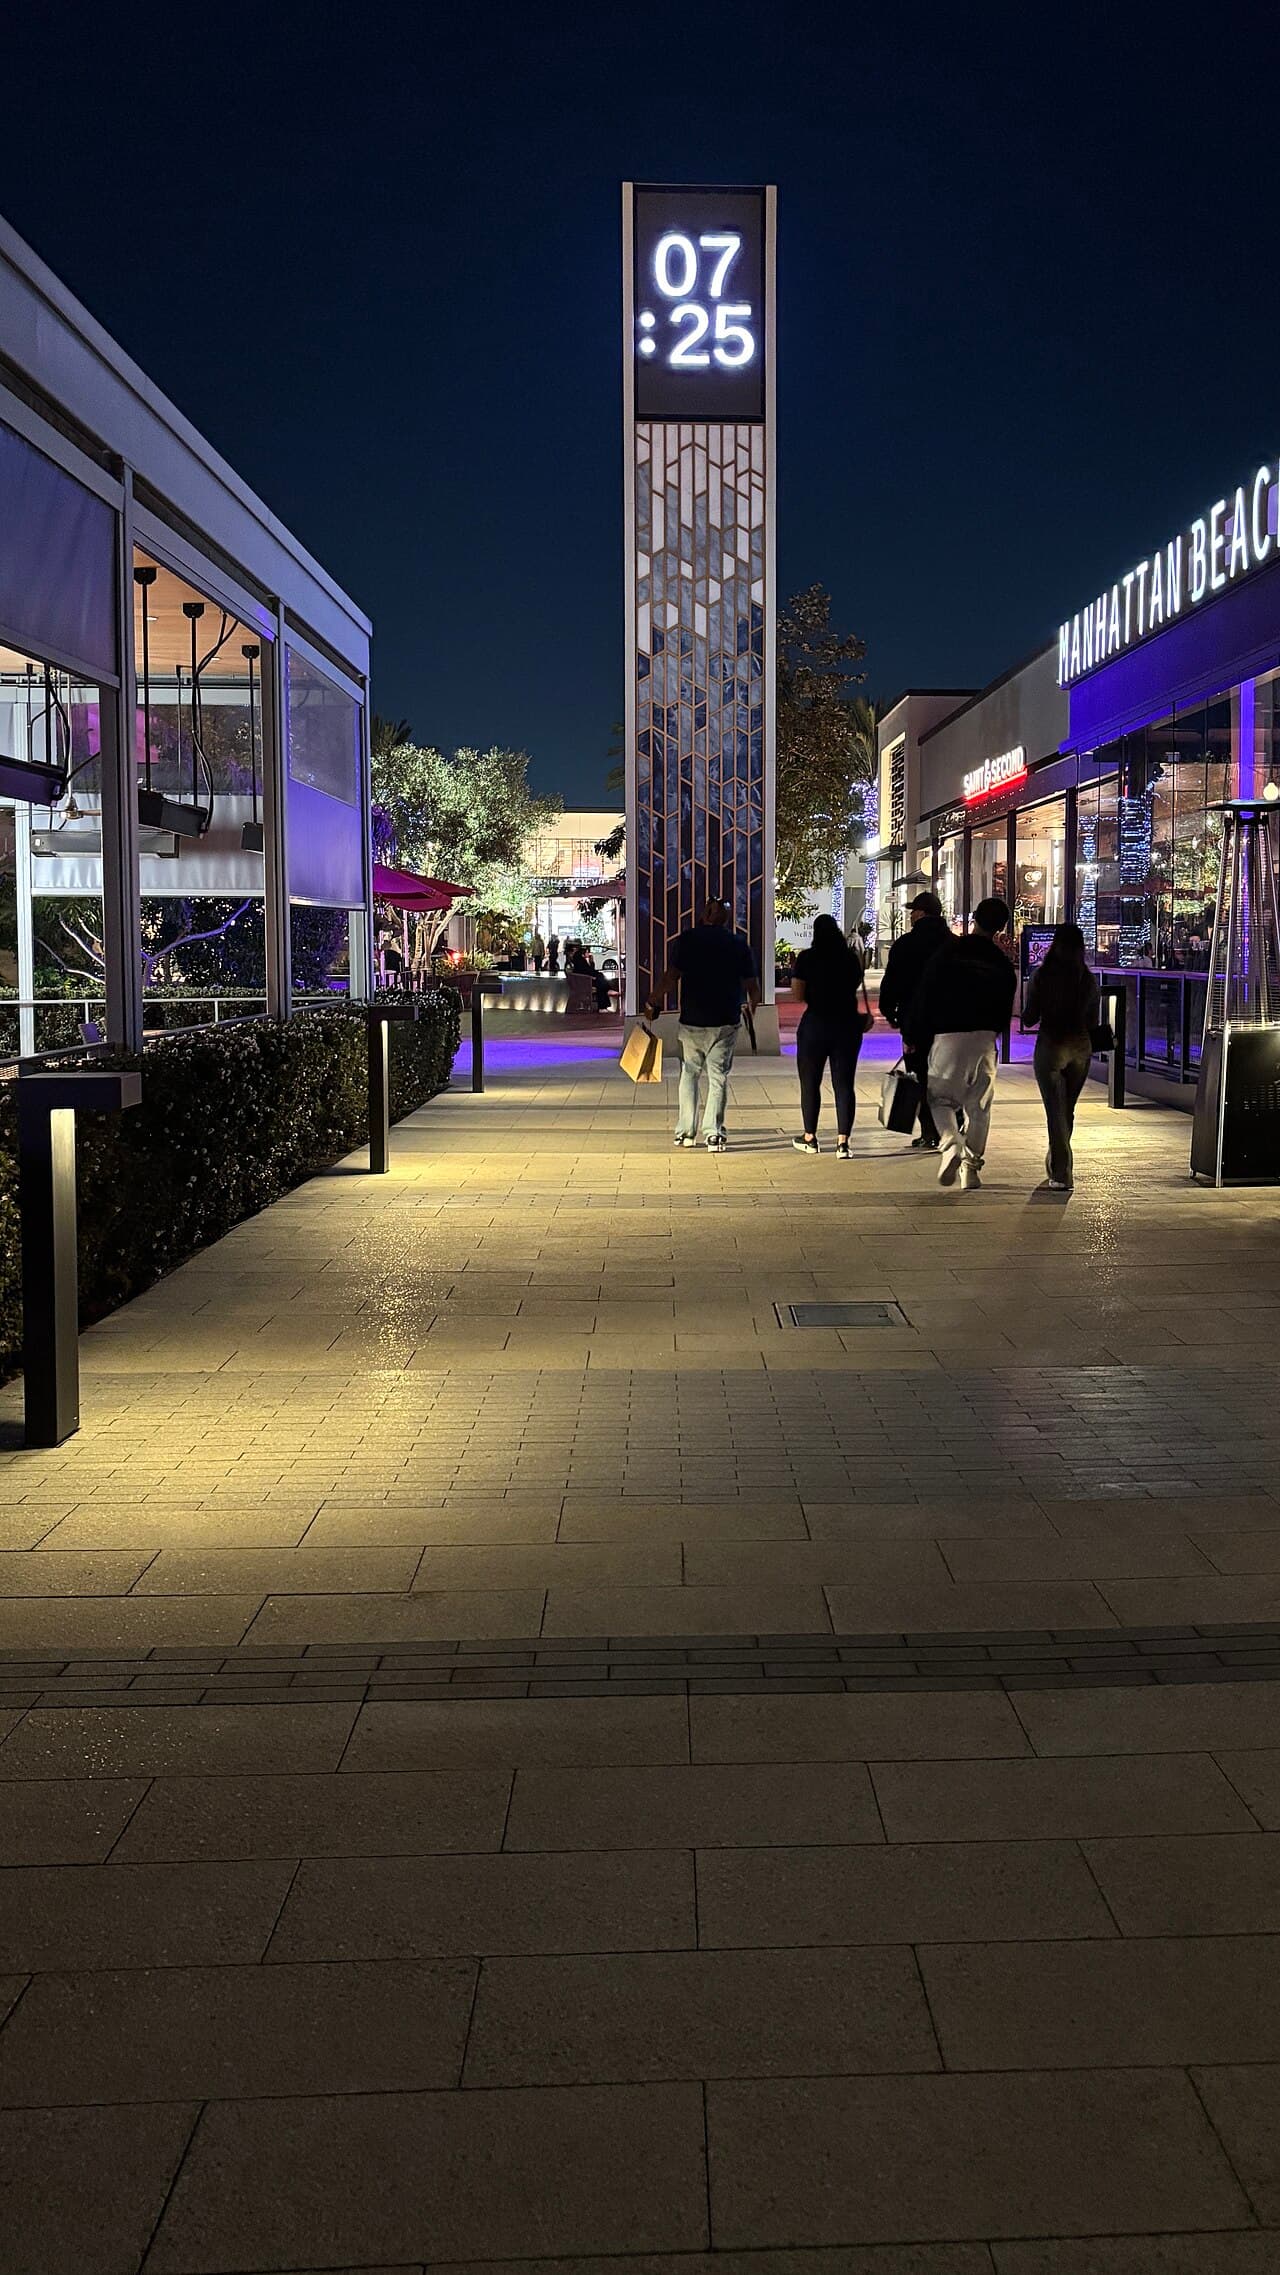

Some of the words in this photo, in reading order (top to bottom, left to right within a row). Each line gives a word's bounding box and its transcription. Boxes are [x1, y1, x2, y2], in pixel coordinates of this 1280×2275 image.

[654, 233, 741, 297] 07
[1057, 535, 1182, 686] MANHATTAN
[1191, 458, 1280, 603] BEAC
[991, 746, 1024, 783] SECOND
